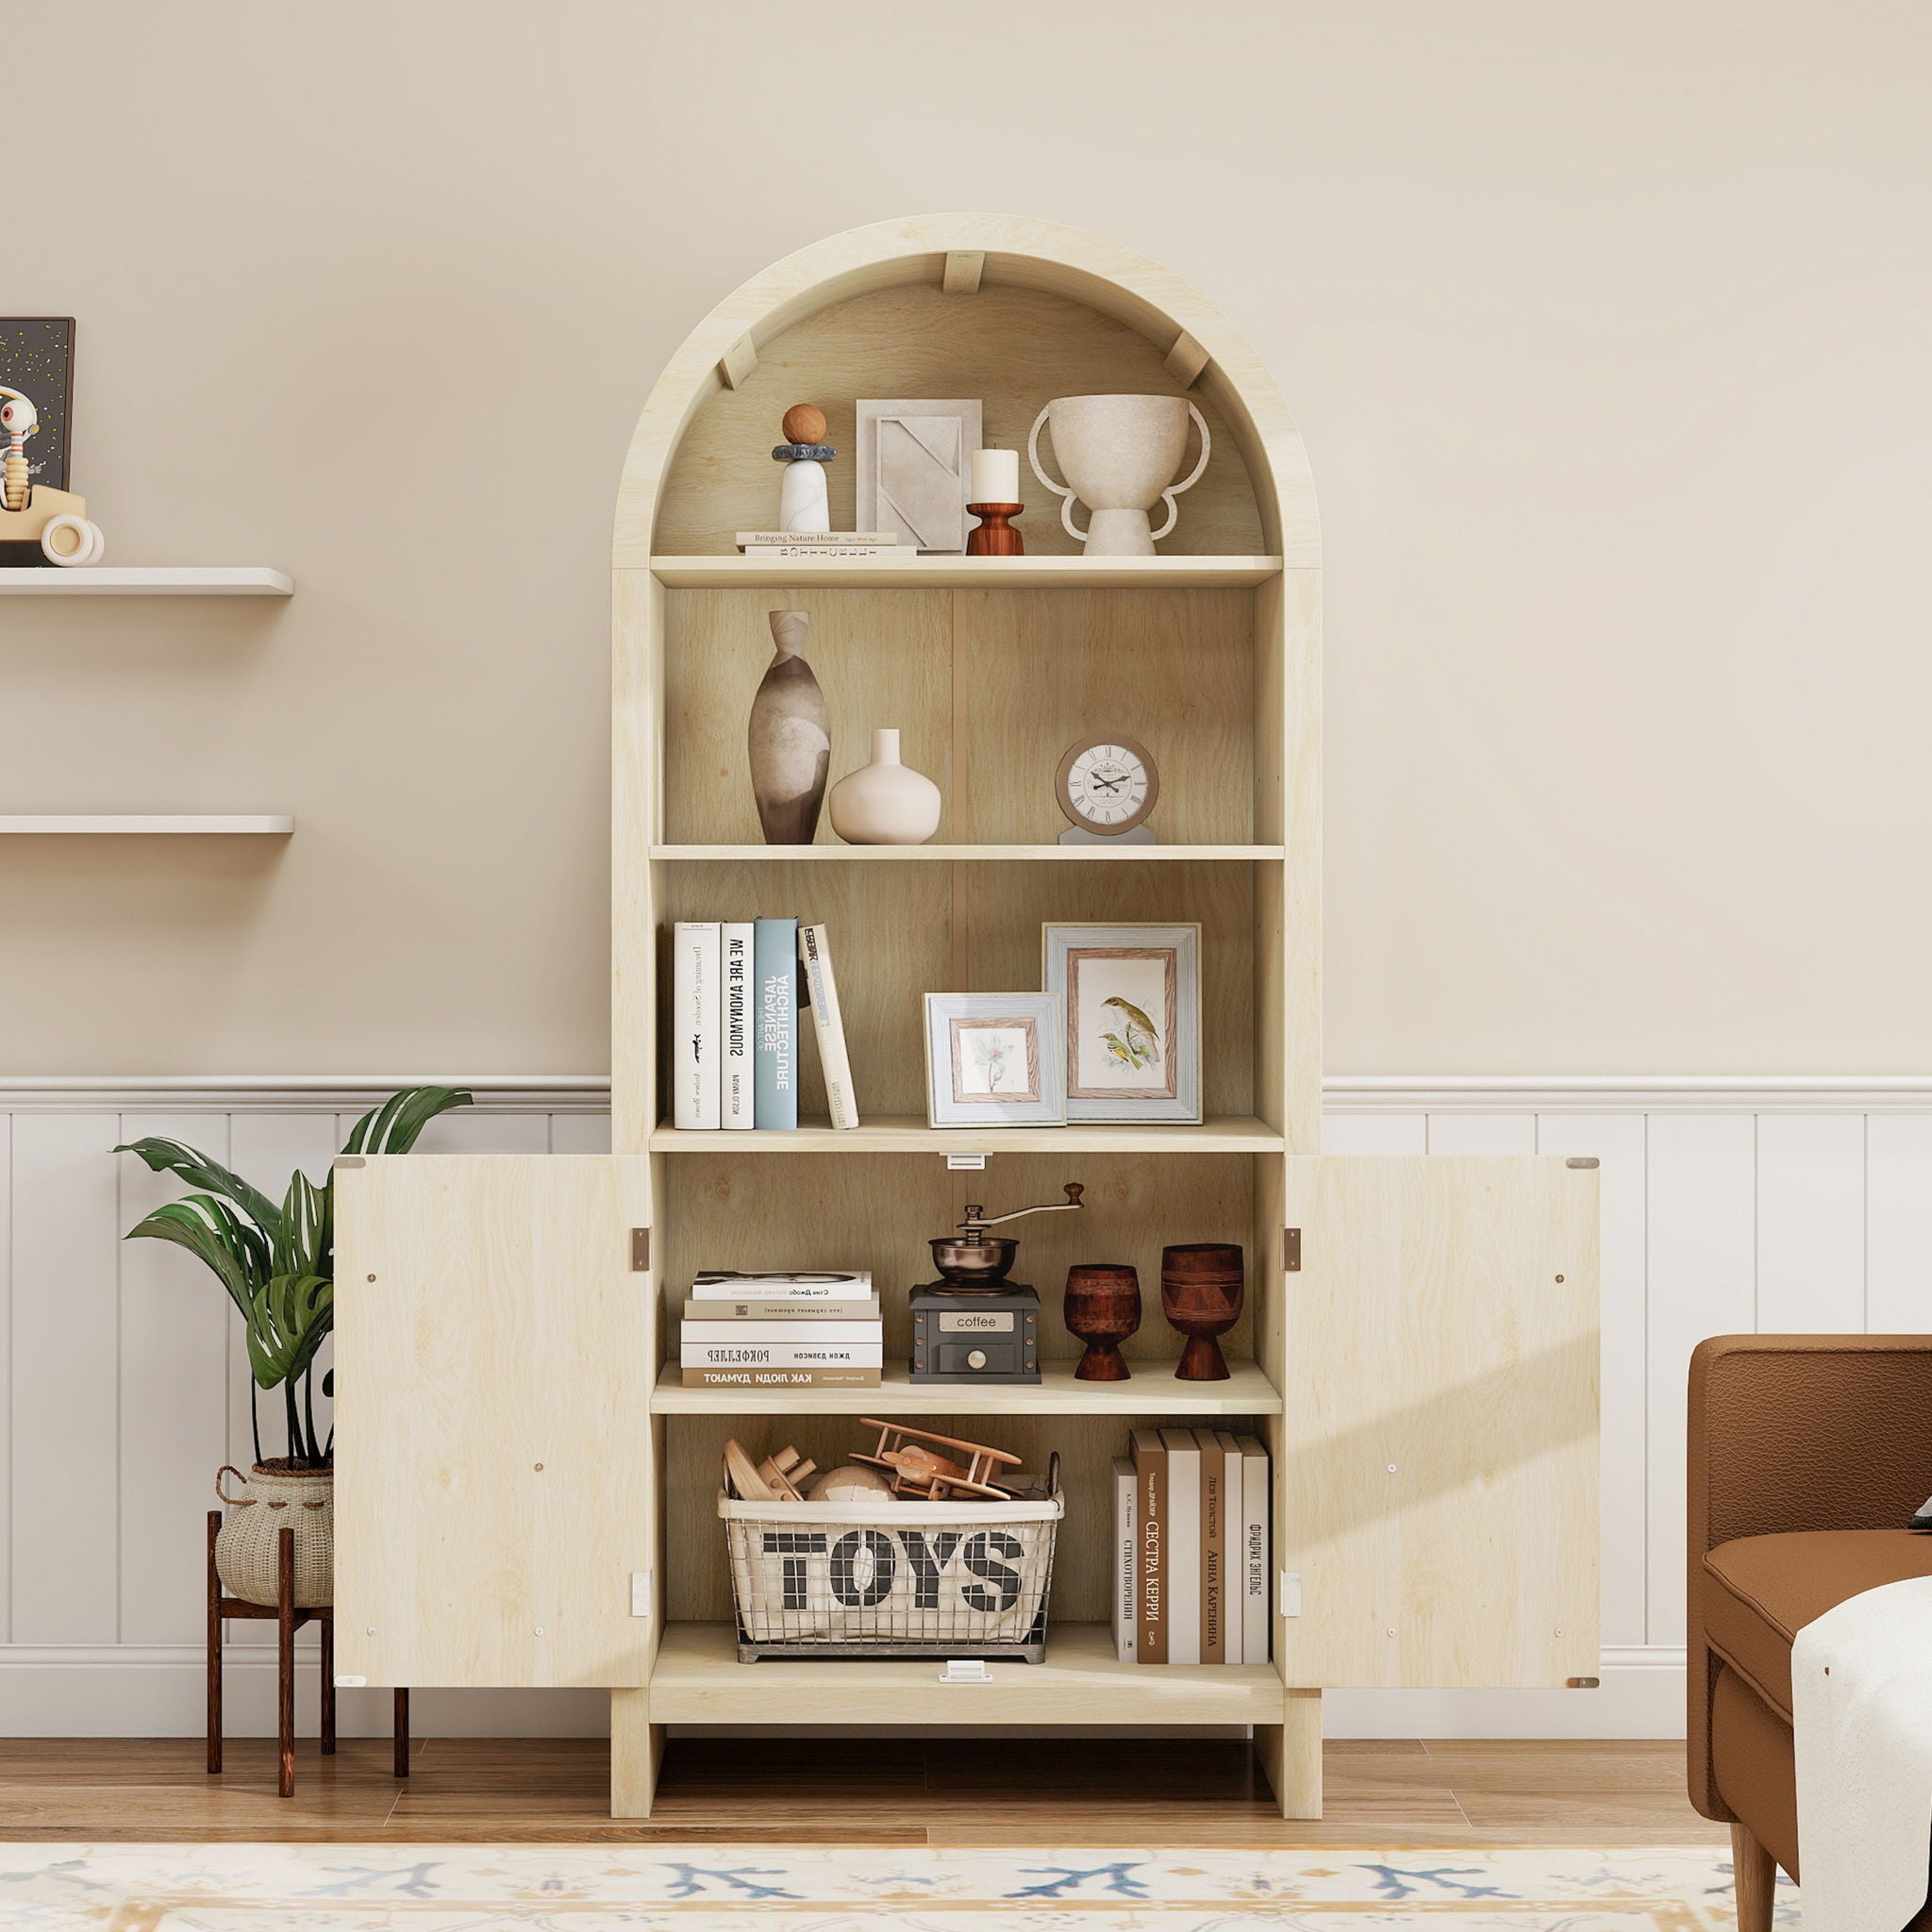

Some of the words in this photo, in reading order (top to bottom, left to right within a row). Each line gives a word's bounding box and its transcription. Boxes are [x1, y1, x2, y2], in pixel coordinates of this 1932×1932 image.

[755, 534, 788, 543] Bringing
[957, 1316, 996, 1327] coffee
[1145, 1521, 1159, 1574] СЕСТРА
[1248, 1524, 1262, 1560] ФРИДРИХ
[762, 1530, 1025, 1612] TOYS
[1124, 1540, 1133, 1620] СТИХОТВОРЕНИЯ
[1249, 1563, 1261, 1596] ЭНГЕЛЬС
[1145, 1577, 1159, 1622] КЕРРИ
